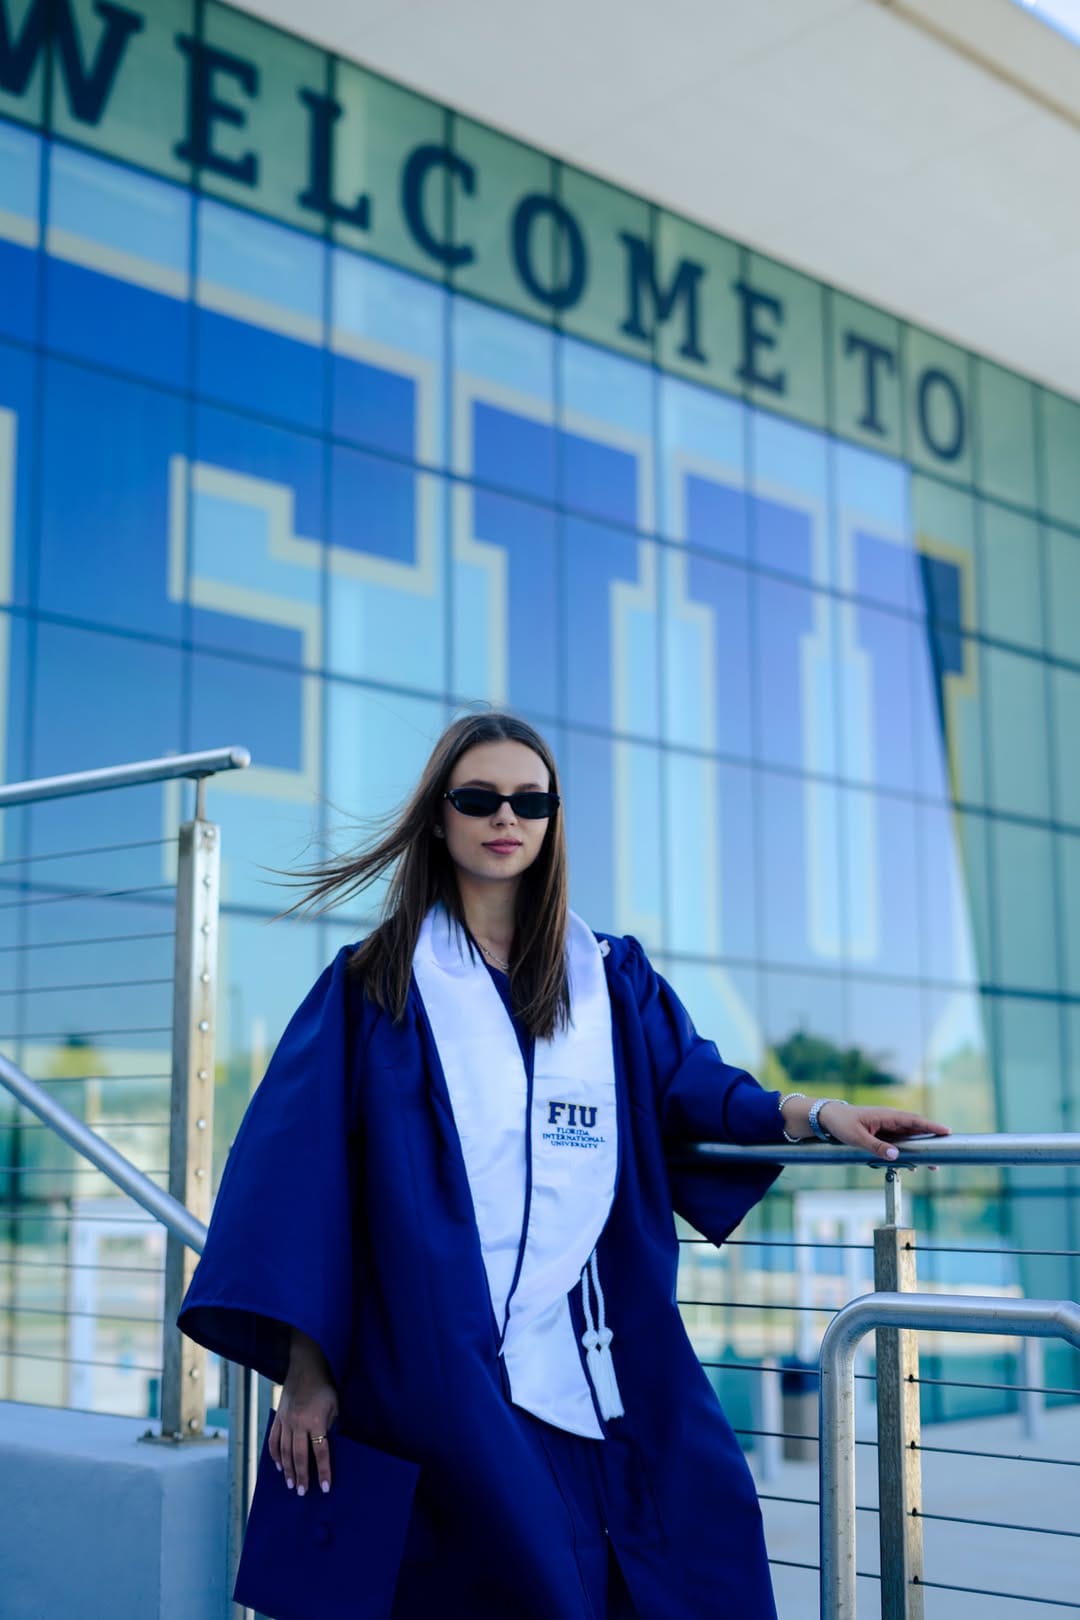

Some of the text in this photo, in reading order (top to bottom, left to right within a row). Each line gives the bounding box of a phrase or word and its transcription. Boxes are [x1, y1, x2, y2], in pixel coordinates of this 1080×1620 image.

[0, 0, 966, 462] WELCOME TO
[0, 212, 978, 1088] FIU
[548, 1101, 597, 1128] FIU
[542, 1133, 606, 1143] INTERNATIONAL
[556, 1127, 589, 1136] FLORIDA
[550, 1140, 599, 1149] UNIVERSITY
